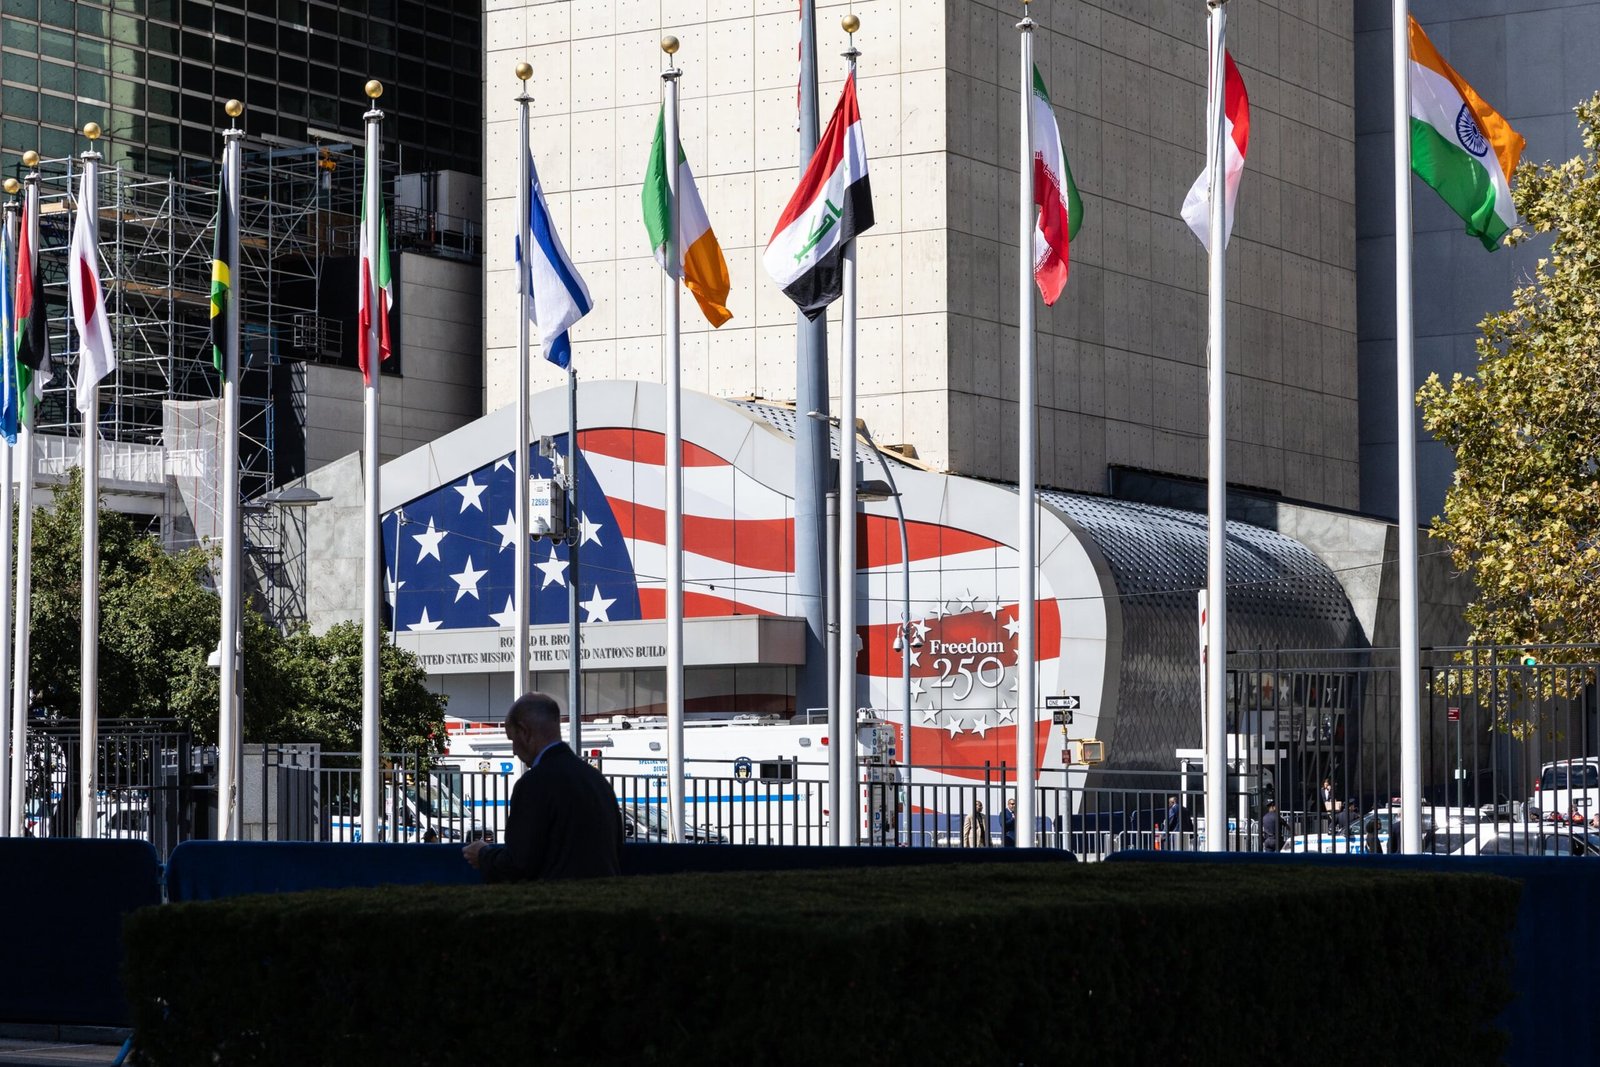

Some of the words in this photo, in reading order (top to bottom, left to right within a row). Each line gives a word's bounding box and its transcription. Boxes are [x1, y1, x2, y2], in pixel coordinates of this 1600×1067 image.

[500, 636, 537, 648] ROD
[539, 635, 549, 646] H.
[551, 633, 585, 646] BRON
[929, 637, 1005, 655] Freedom
[416, 654, 444, 666] NITED
[445, 653, 479, 665] STATES
[533, 649, 552, 661] THE
[592, 646, 634, 659] NATIONS
[636, 645, 667, 658] BUILD
[931, 655, 1006, 702] 250
